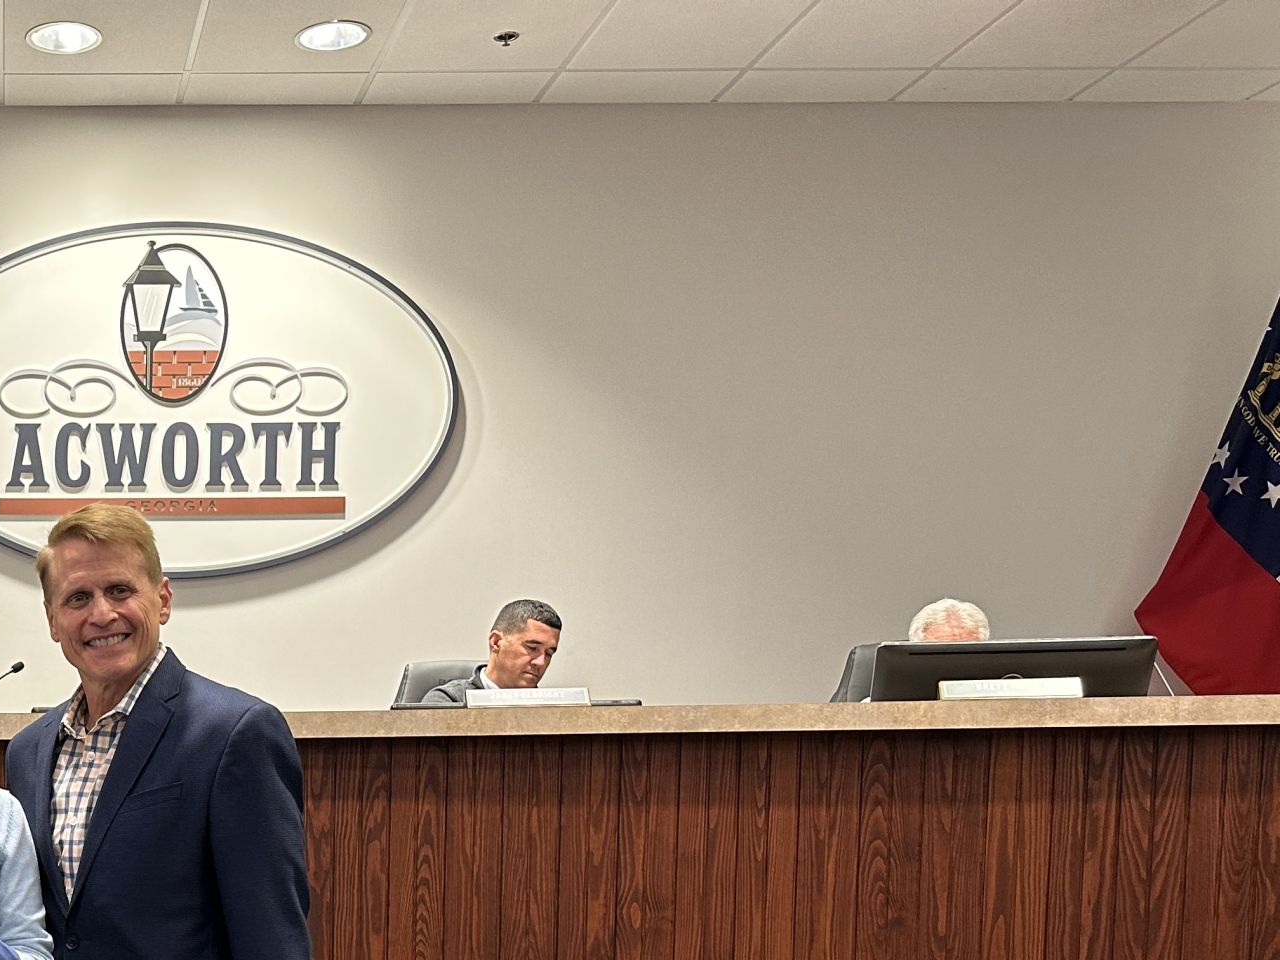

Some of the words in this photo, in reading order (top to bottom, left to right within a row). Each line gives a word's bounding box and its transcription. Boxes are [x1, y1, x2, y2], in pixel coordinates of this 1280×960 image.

[177, 377, 203, 387] 1860
[5, 421, 341, 493] ACWORTH
[1266, 442, 1280, 465] TRU
[125, 500, 218, 512] GEORGIA
